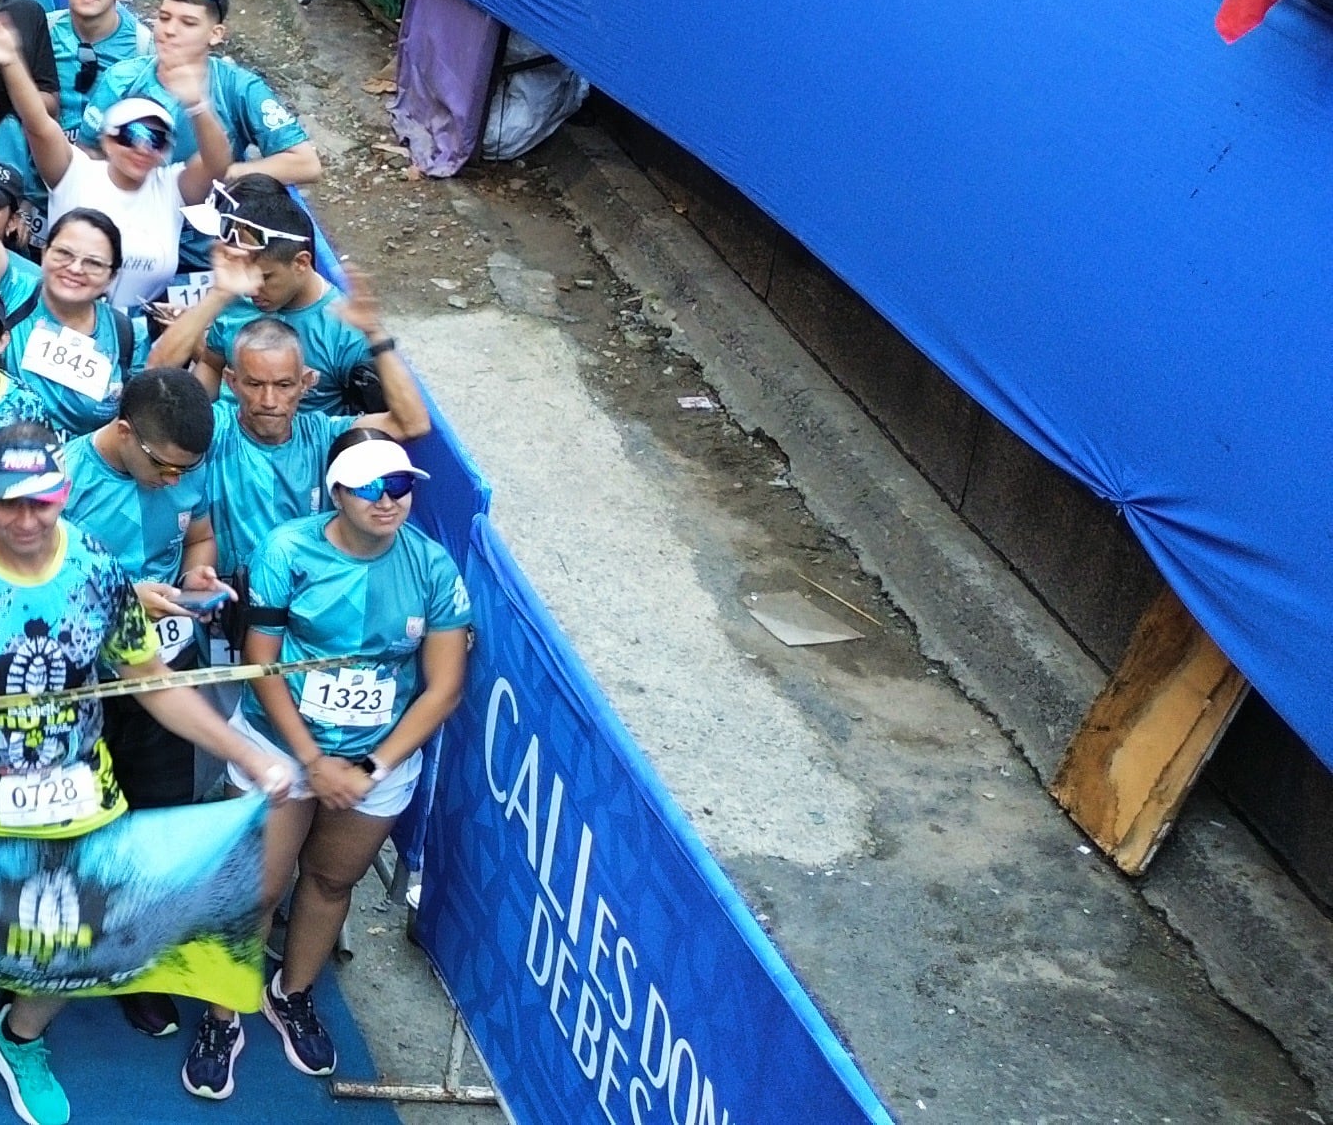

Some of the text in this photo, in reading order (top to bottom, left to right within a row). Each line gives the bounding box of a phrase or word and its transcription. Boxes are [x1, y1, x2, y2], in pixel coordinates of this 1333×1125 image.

[41, 341, 98, 378] 1845
[318, 683, 382, 710] 1323
[12, 778, 78, 808] 0728
[484, 677, 593, 945] CALI
[589, 894, 637, 1031] ES
